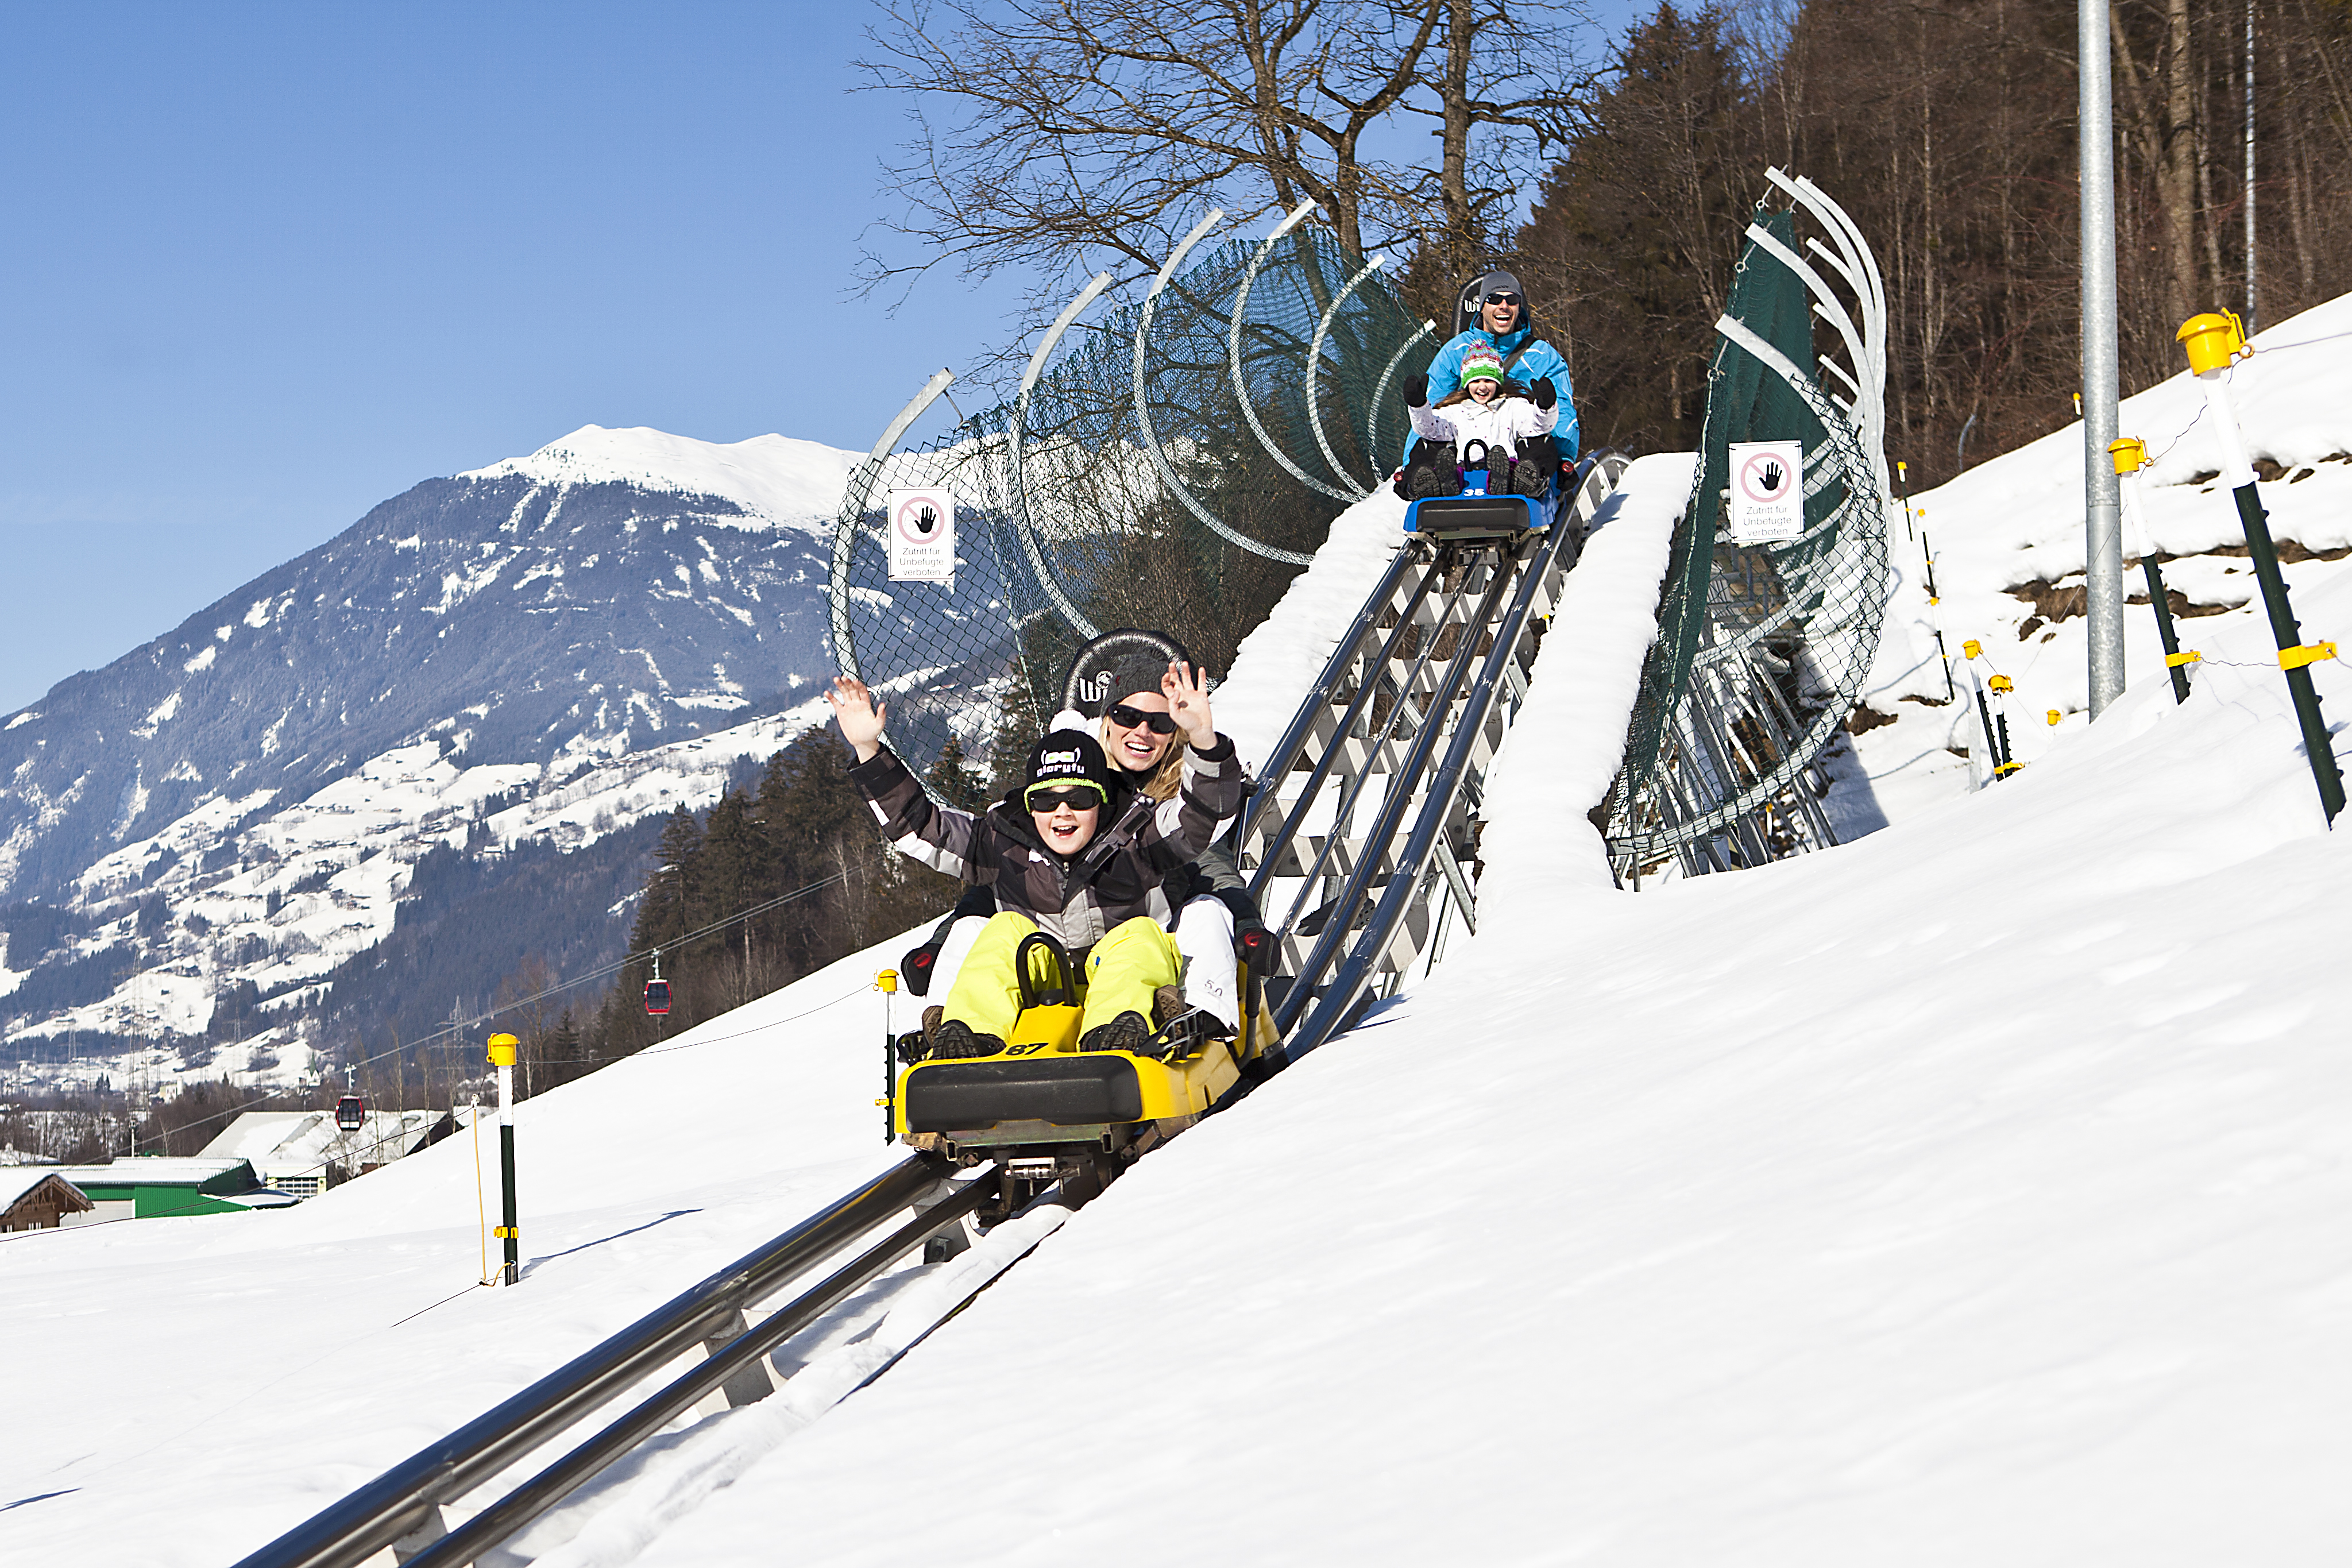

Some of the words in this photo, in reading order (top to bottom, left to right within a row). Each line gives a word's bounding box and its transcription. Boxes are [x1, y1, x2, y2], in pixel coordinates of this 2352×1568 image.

[1463, 488, 1485, 496] 35
[1746, 505, 1773, 515] Zutritt
[1743, 516, 1791, 526] Unbefugte
[1747, 528, 1788, 536] verboten
[899, 558, 944, 567] Unbefugte
[1037, 763, 1084, 777] gloryfy
[1005, 1042, 1049, 1056] 87
